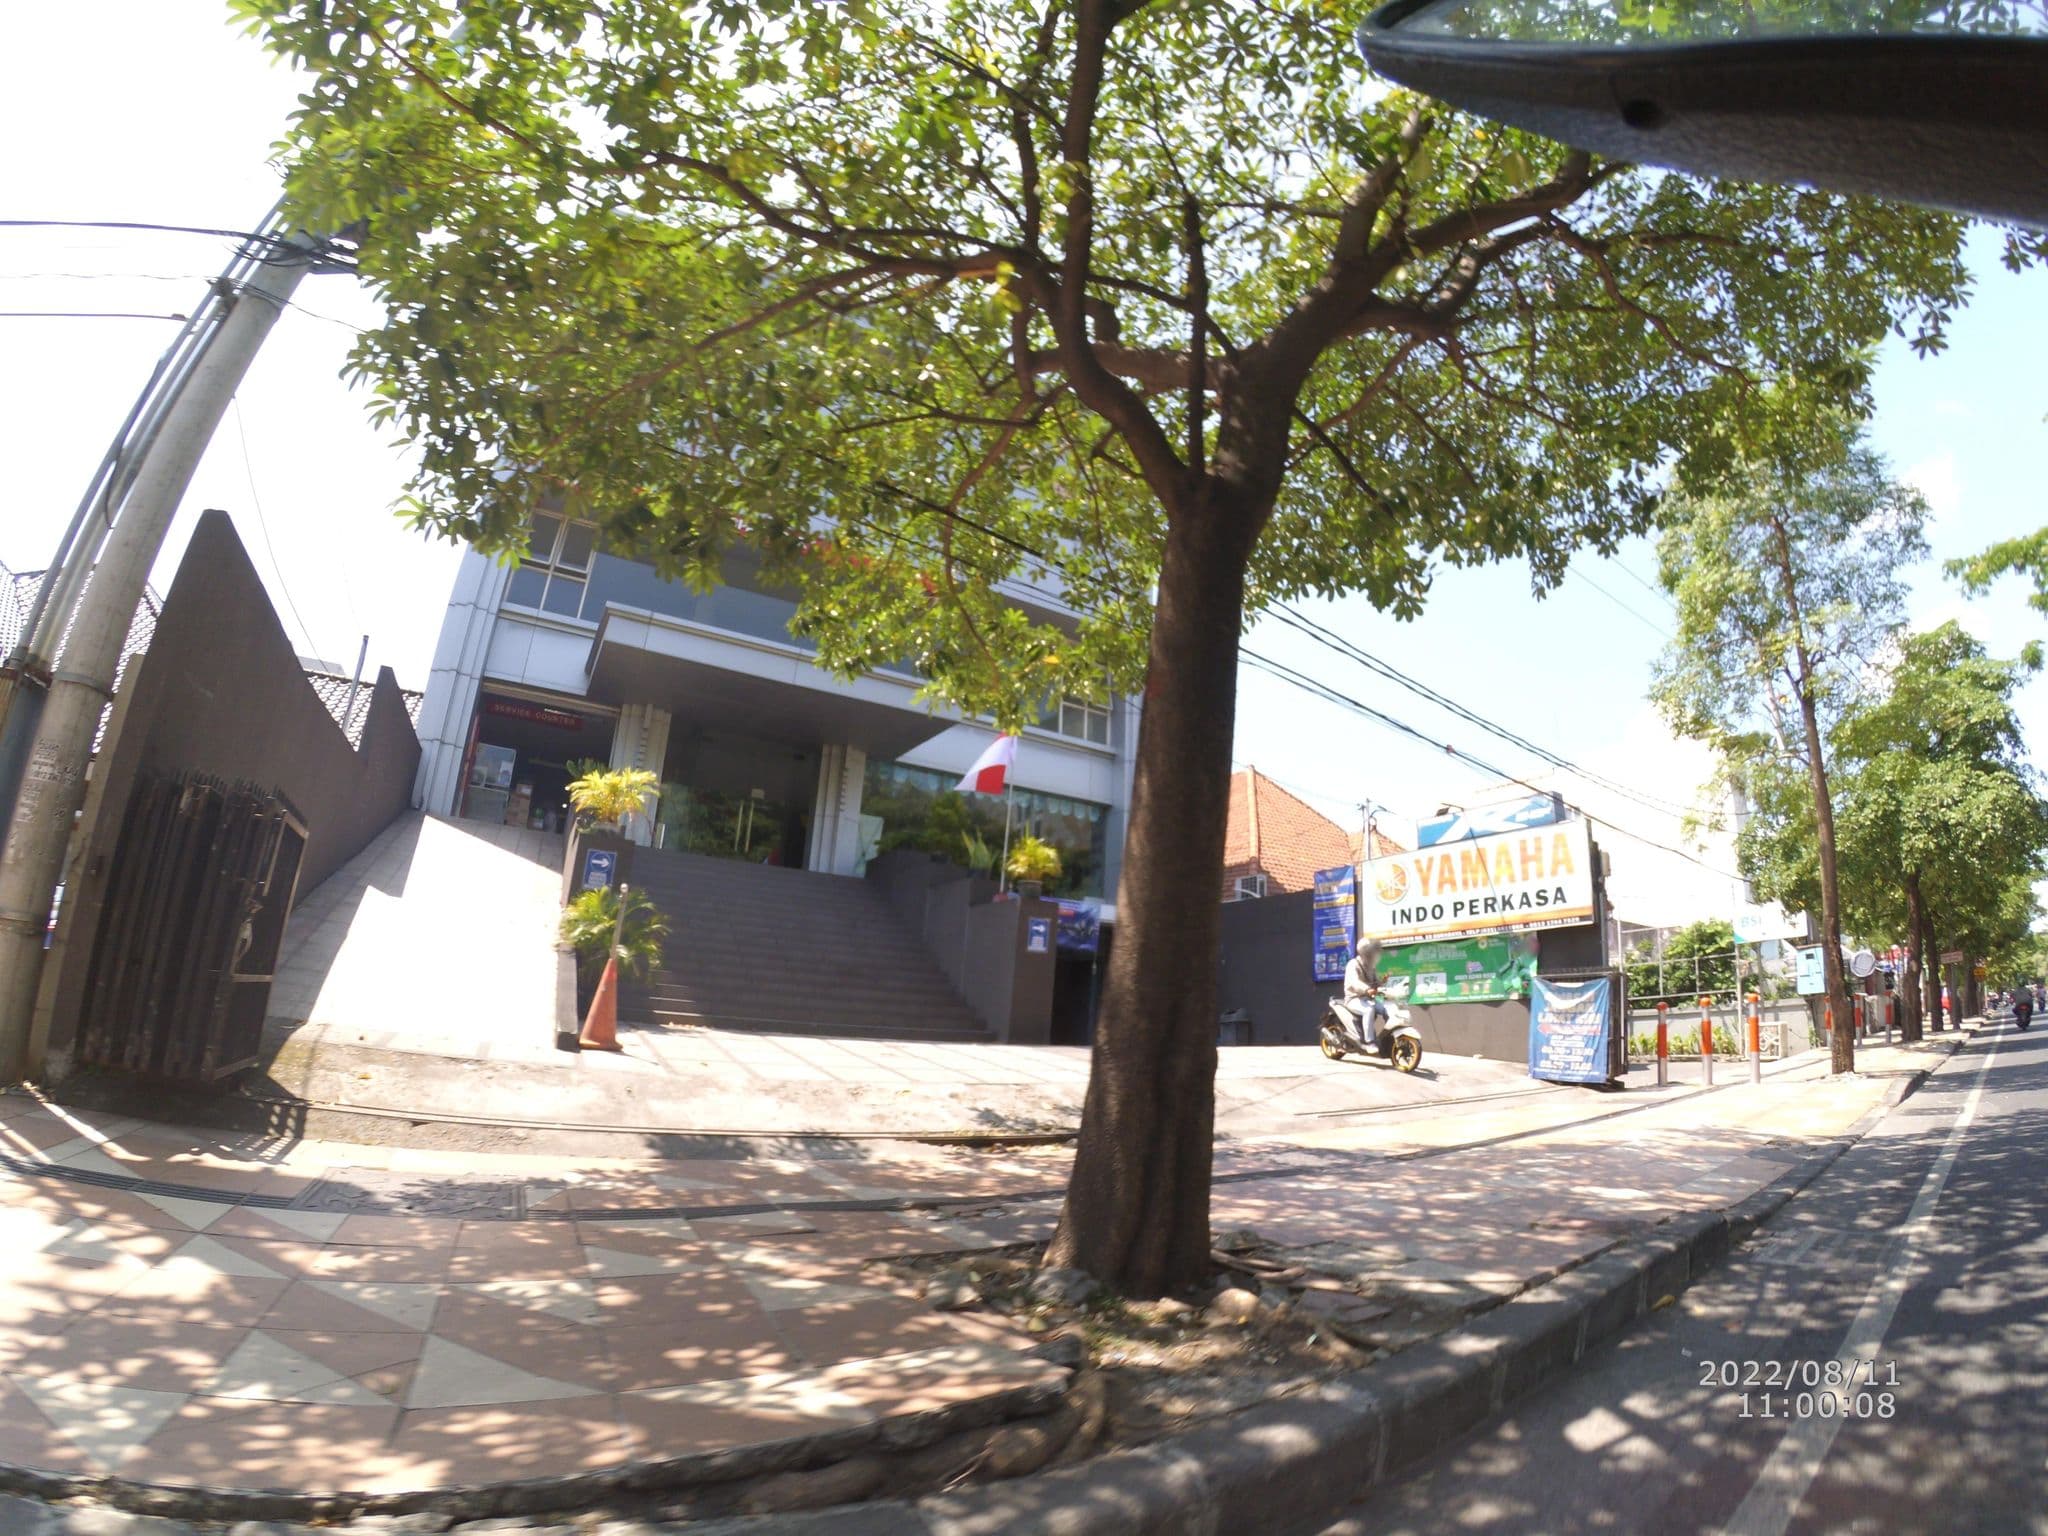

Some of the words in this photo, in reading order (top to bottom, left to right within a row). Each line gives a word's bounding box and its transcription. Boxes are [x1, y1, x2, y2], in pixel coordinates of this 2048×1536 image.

[1413, 832, 1575, 898] YAMAHA
[1391, 903, 1444, 926] INDO
[1452, 886, 1568, 919] PERKASA
